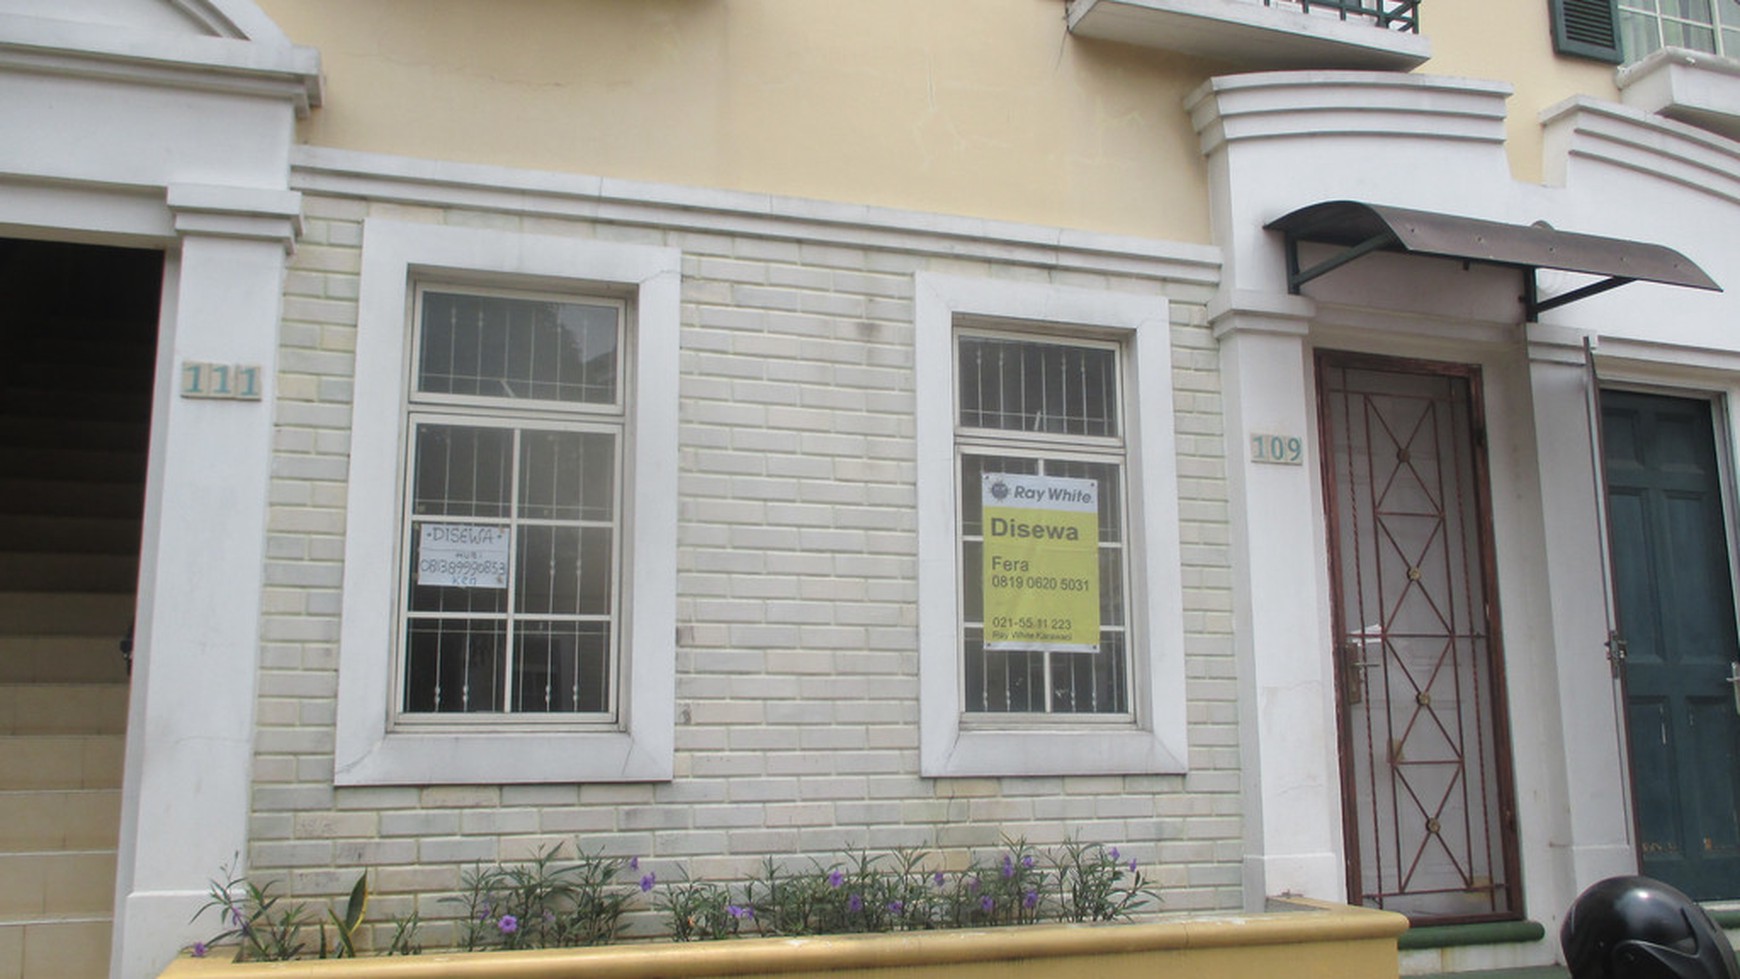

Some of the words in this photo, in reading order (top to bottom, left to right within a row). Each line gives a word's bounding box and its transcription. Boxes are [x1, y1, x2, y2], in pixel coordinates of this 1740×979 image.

[184, 366, 259, 396] 111
[1253, 436, 1301, 461] 109
[1014, 486, 1045, 501] Ray
[1048, 488, 1092, 503] White
[991, 517, 1079, 541] Disewa
[992, 556, 1029, 571] Fera
[992, 575, 1024, 588] 0819
[1026, 577, 1057, 590] 0620
[1060, 578, 1089, 591] 5031
[1051, 619, 1072, 630] 223
